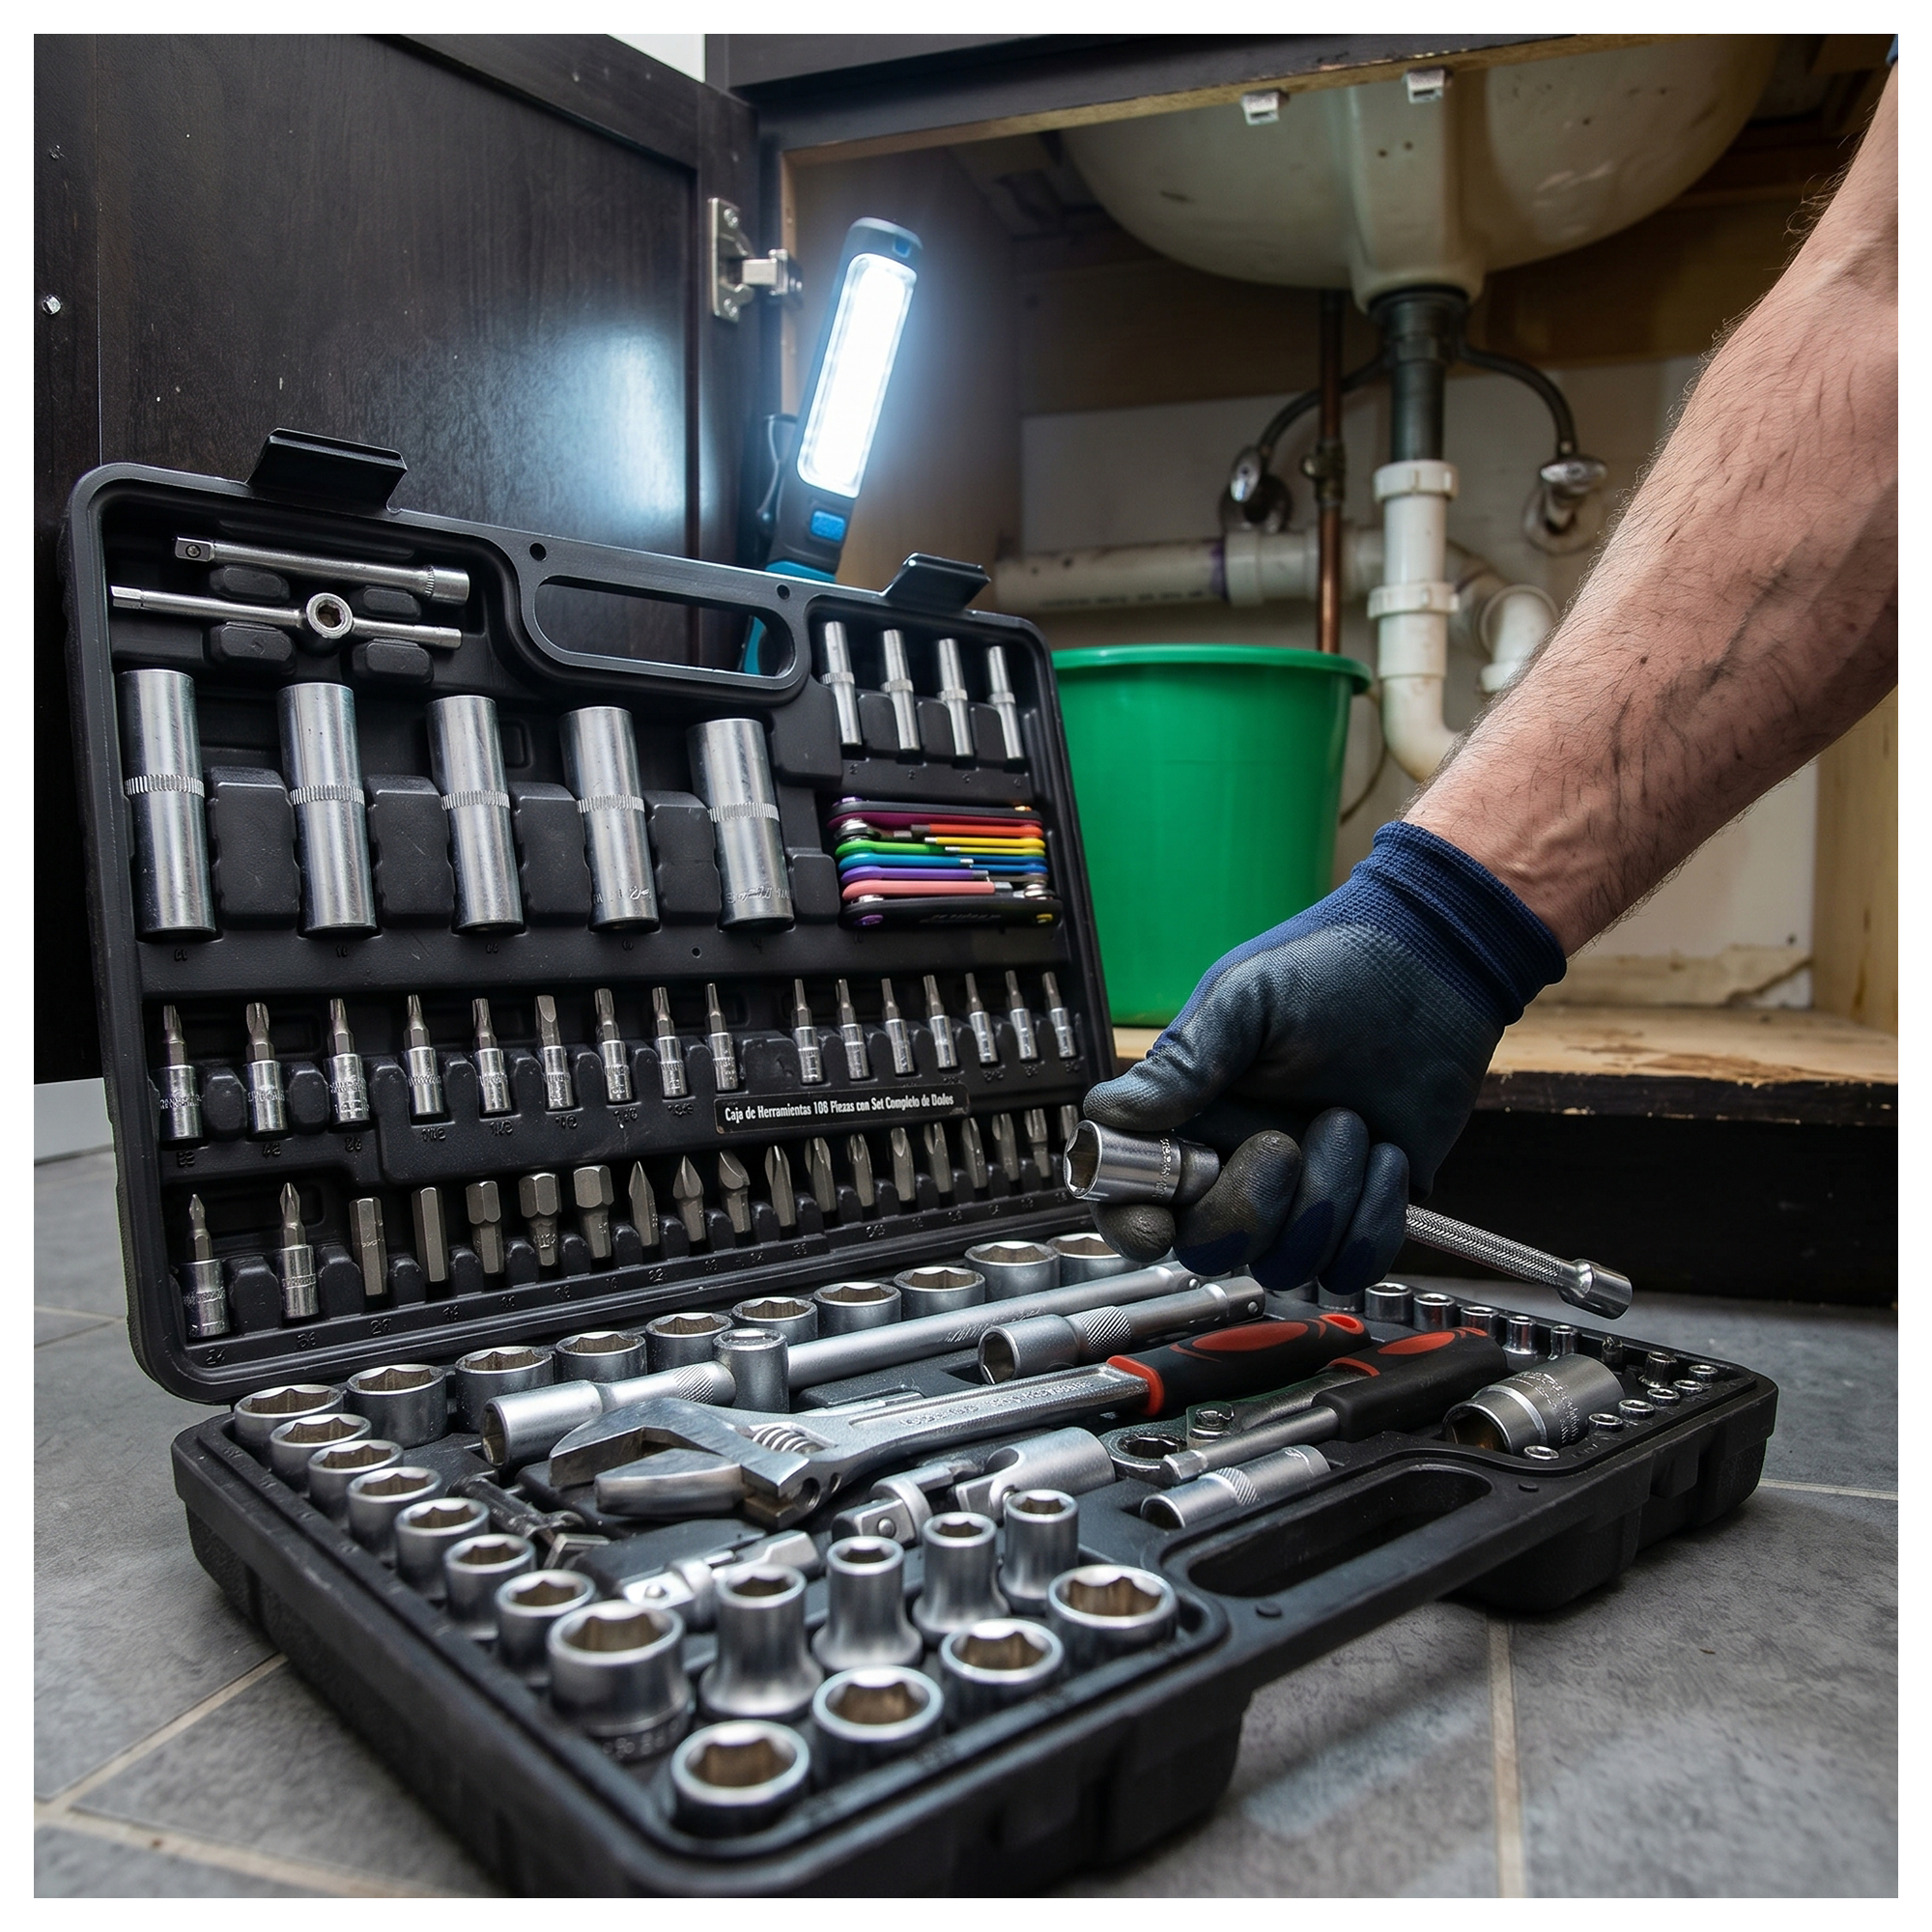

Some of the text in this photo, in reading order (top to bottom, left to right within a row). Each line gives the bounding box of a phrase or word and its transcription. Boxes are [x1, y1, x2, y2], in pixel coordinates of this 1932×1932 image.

[724, 1107, 744, 1123] Caja
[745, 1105, 756, 1120] de
[757, 1102, 812, 1119] Herramientas
[830, 1099, 855, 1114] Piezas
[856, 1100, 870, 1112] con
[870, 1096, 885, 1111] Set
[921, 1094, 931, 1107] de
